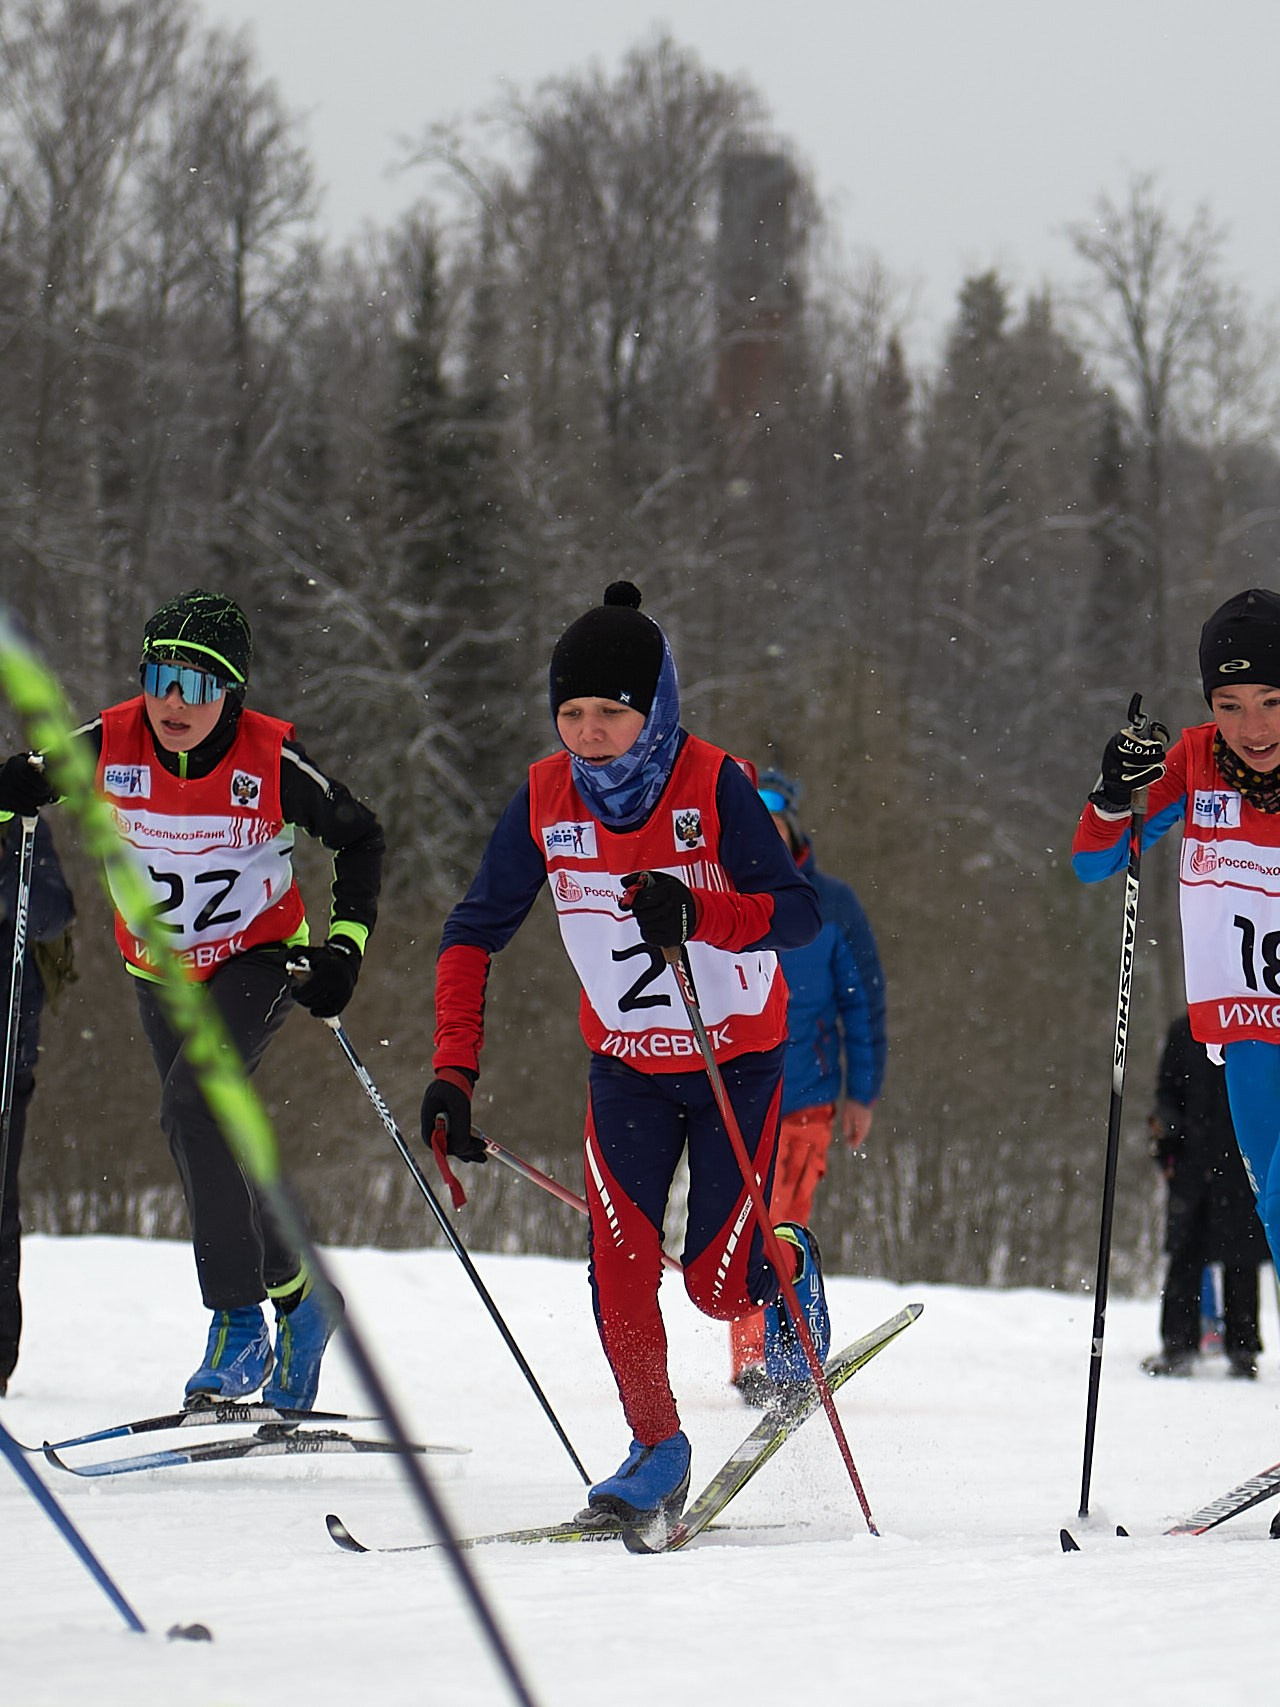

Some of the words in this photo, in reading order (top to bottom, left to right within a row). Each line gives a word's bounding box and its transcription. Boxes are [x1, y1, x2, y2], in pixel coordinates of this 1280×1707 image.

[147, 865, 241, 934] 22
[263, 878, 273, 901] 1
[734, 964, 749, 991] 1
[1113, 882, 1139, 1068] MADSHUS
[808, 1273, 824, 1350] SPINE
